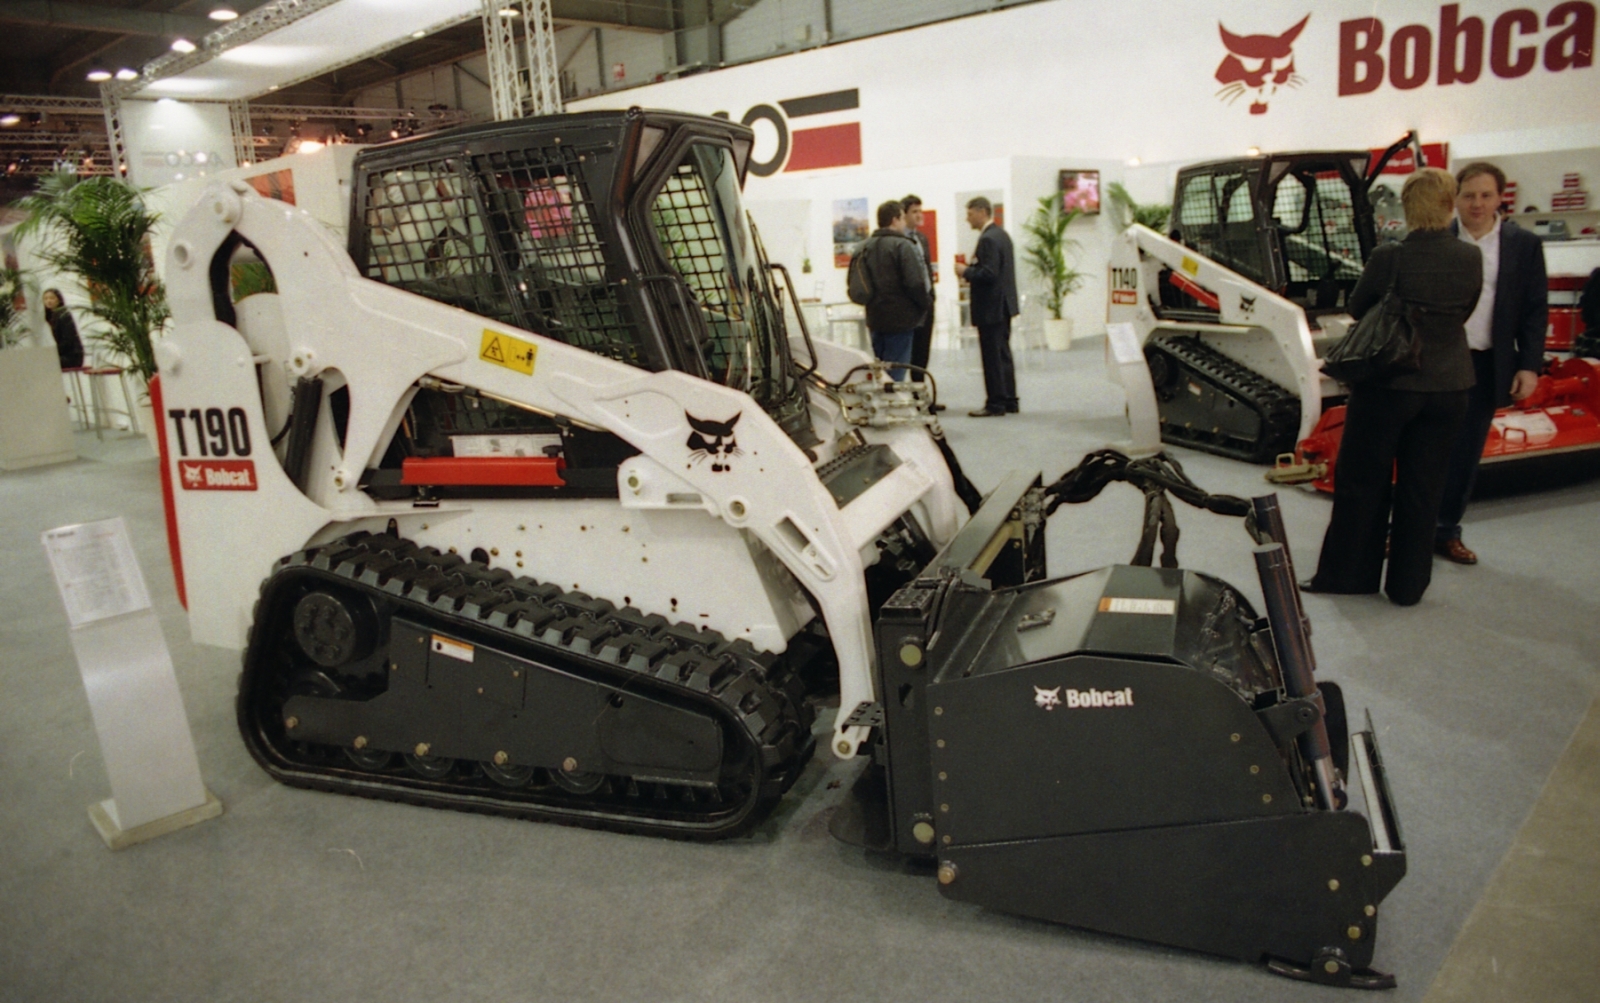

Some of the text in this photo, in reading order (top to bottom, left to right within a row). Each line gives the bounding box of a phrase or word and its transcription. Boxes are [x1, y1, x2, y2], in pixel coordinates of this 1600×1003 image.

[1112, 267, 1137, 290] T140
[168, 406, 252, 457] T190
[204, 467, 252, 487] Bobcat
[1065, 687, 1134, 708] Bobcat
